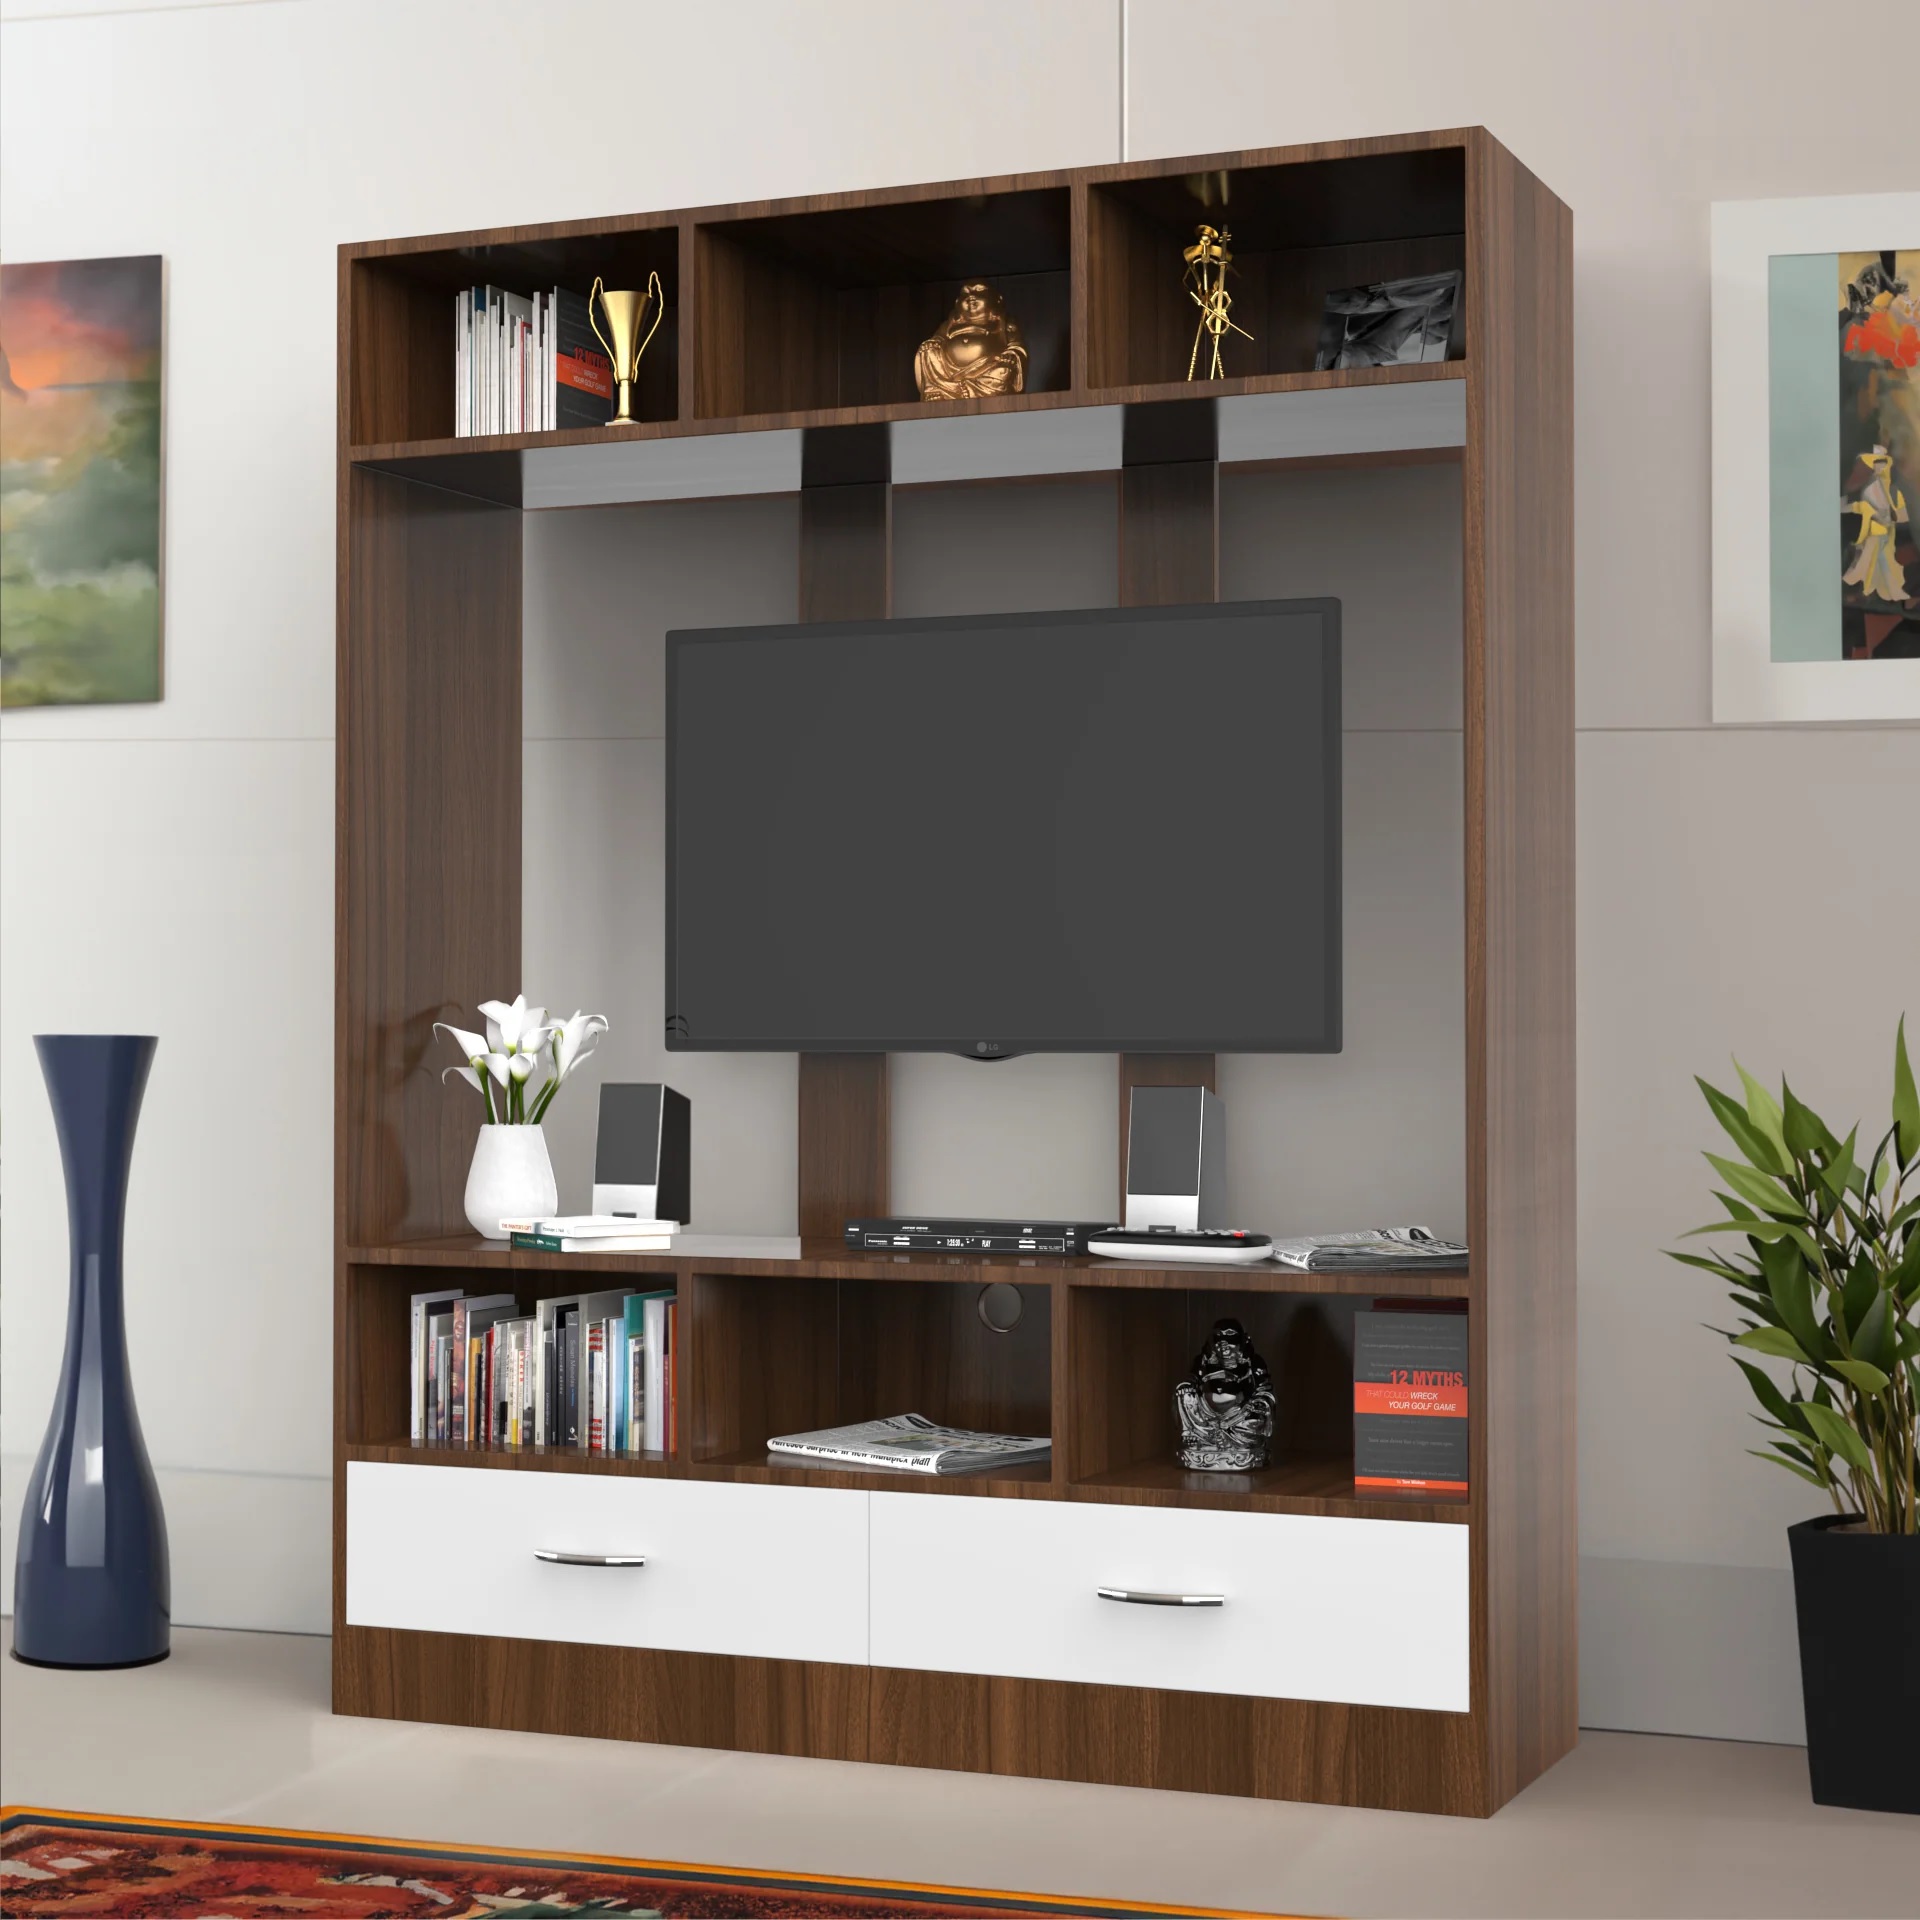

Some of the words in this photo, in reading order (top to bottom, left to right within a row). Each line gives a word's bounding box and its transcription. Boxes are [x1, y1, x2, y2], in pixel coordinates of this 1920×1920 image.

[574, 346, 583, 361] 12
[585, 350, 609, 370] MYTHS
[988, 1043, 999, 1051] LG
[981, 1239, 992, 1248] PLAY
[1390, 1369, 1408, 1385] 12
[1412, 1369, 1464, 1387] MYTHS
[1366, 1389, 1382, 1398] THAT
[1383, 1391, 1409, 1399] COULD
[1410, 1391, 1438, 1400] WRECK
[1389, 1401, 1410, 1410] YOUR
[1411, 1402, 1432, 1410] GOLF
[1433, 1402, 1456, 1412] GAME
